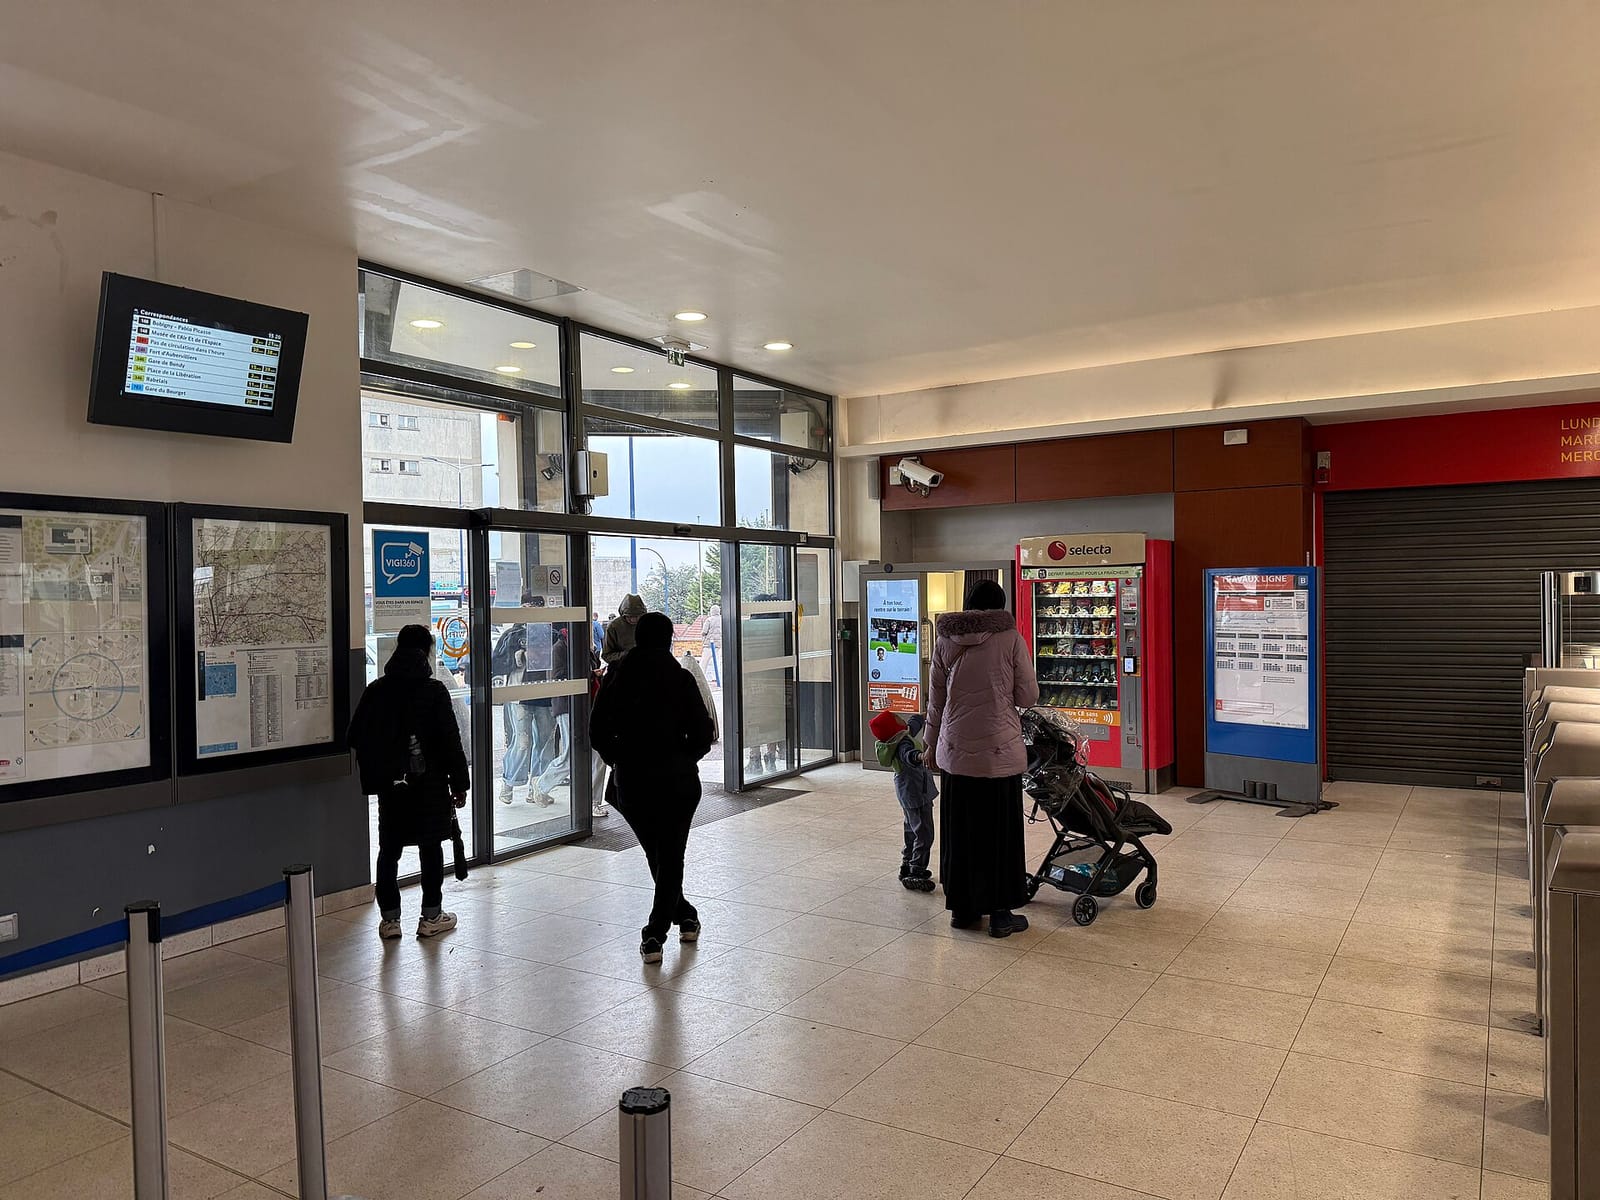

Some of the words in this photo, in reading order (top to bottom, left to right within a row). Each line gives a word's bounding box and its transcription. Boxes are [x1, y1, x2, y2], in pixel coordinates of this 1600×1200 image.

[139, 309, 189, 323] Correspondances
[151, 320, 173, 329] Bobigny
[192, 327, 211, 335] Picasso
[150, 329, 168, 337] Musée
[167, 342, 194, 350] circulation
[160, 350, 197, 360] d'Aubervilliers
[175, 371, 201, 379] Libération
[165, 388, 186, 396] Bourget
[1069, 544, 1112, 556] selecta
[385, 558, 416, 568] VIGI360
[1261, 575, 1287, 583] LIGNE
